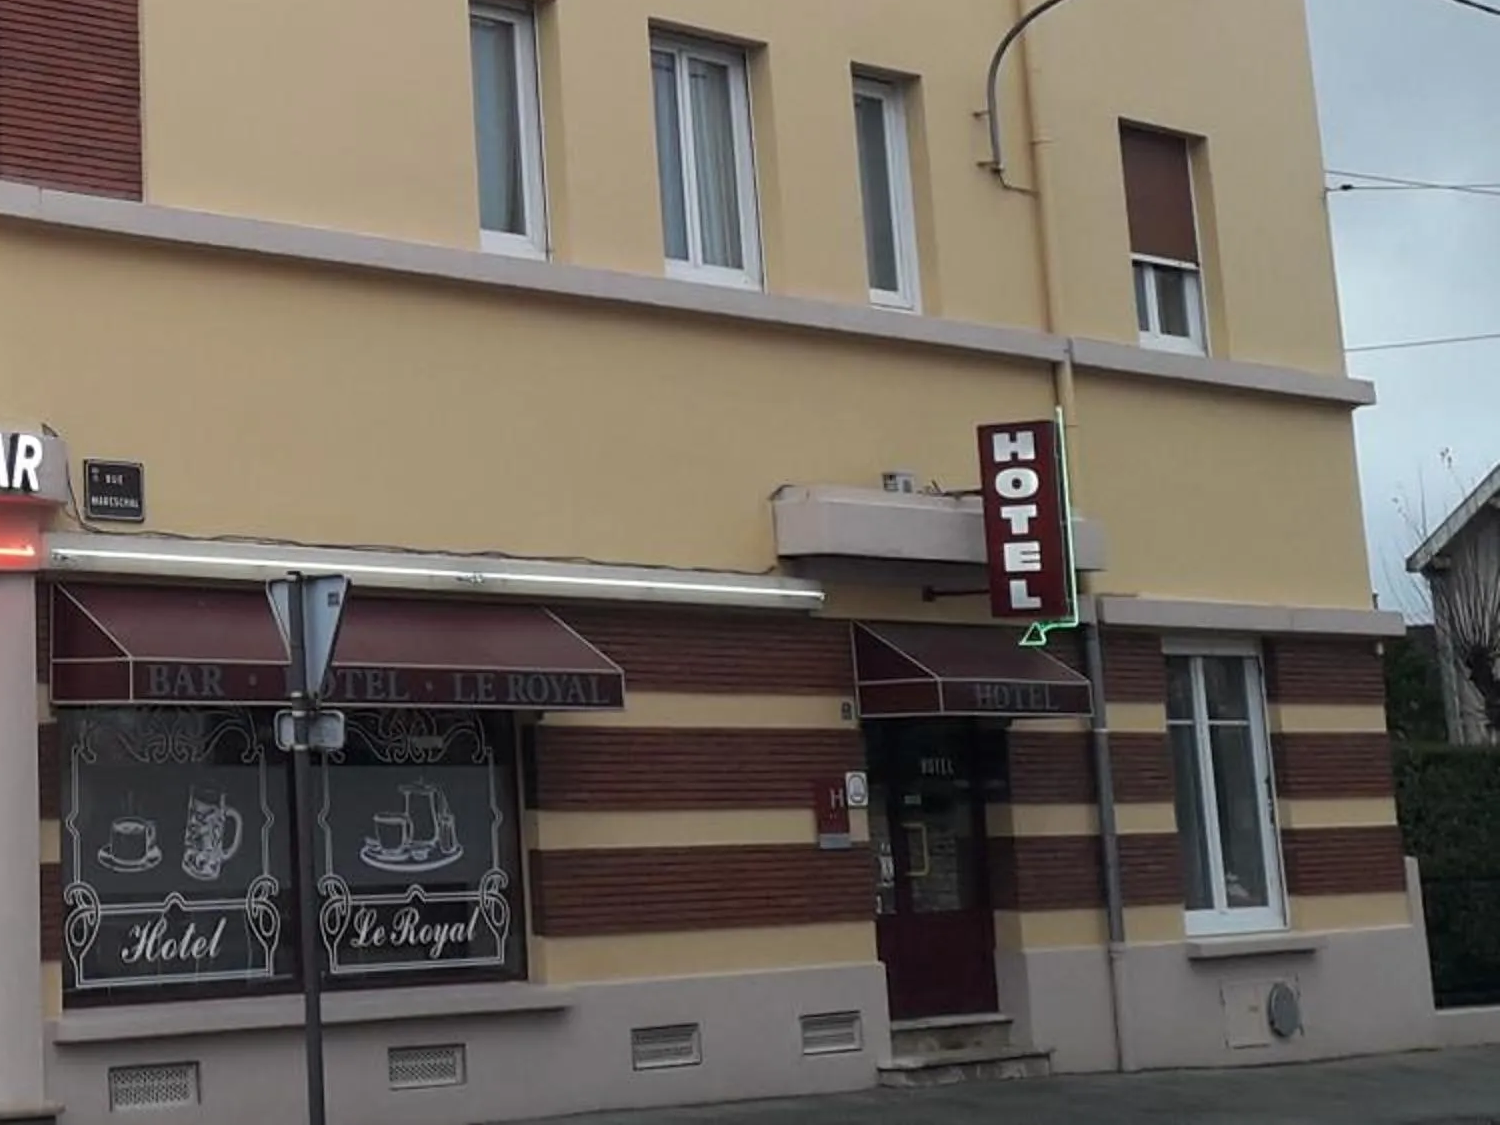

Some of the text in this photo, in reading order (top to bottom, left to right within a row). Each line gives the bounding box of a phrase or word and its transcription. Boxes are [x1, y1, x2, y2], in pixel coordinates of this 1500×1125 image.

[991, 429, 1042, 610] HOTEL
[146, 664, 227, 697] BAR
[453, 673, 497, 703] LE
[505, 674, 610, 704] ROYAL
[972, 683, 1061, 710] HOTEL
[121, 912, 228, 964] Hotel
[350, 905, 480, 960] Le Royal
